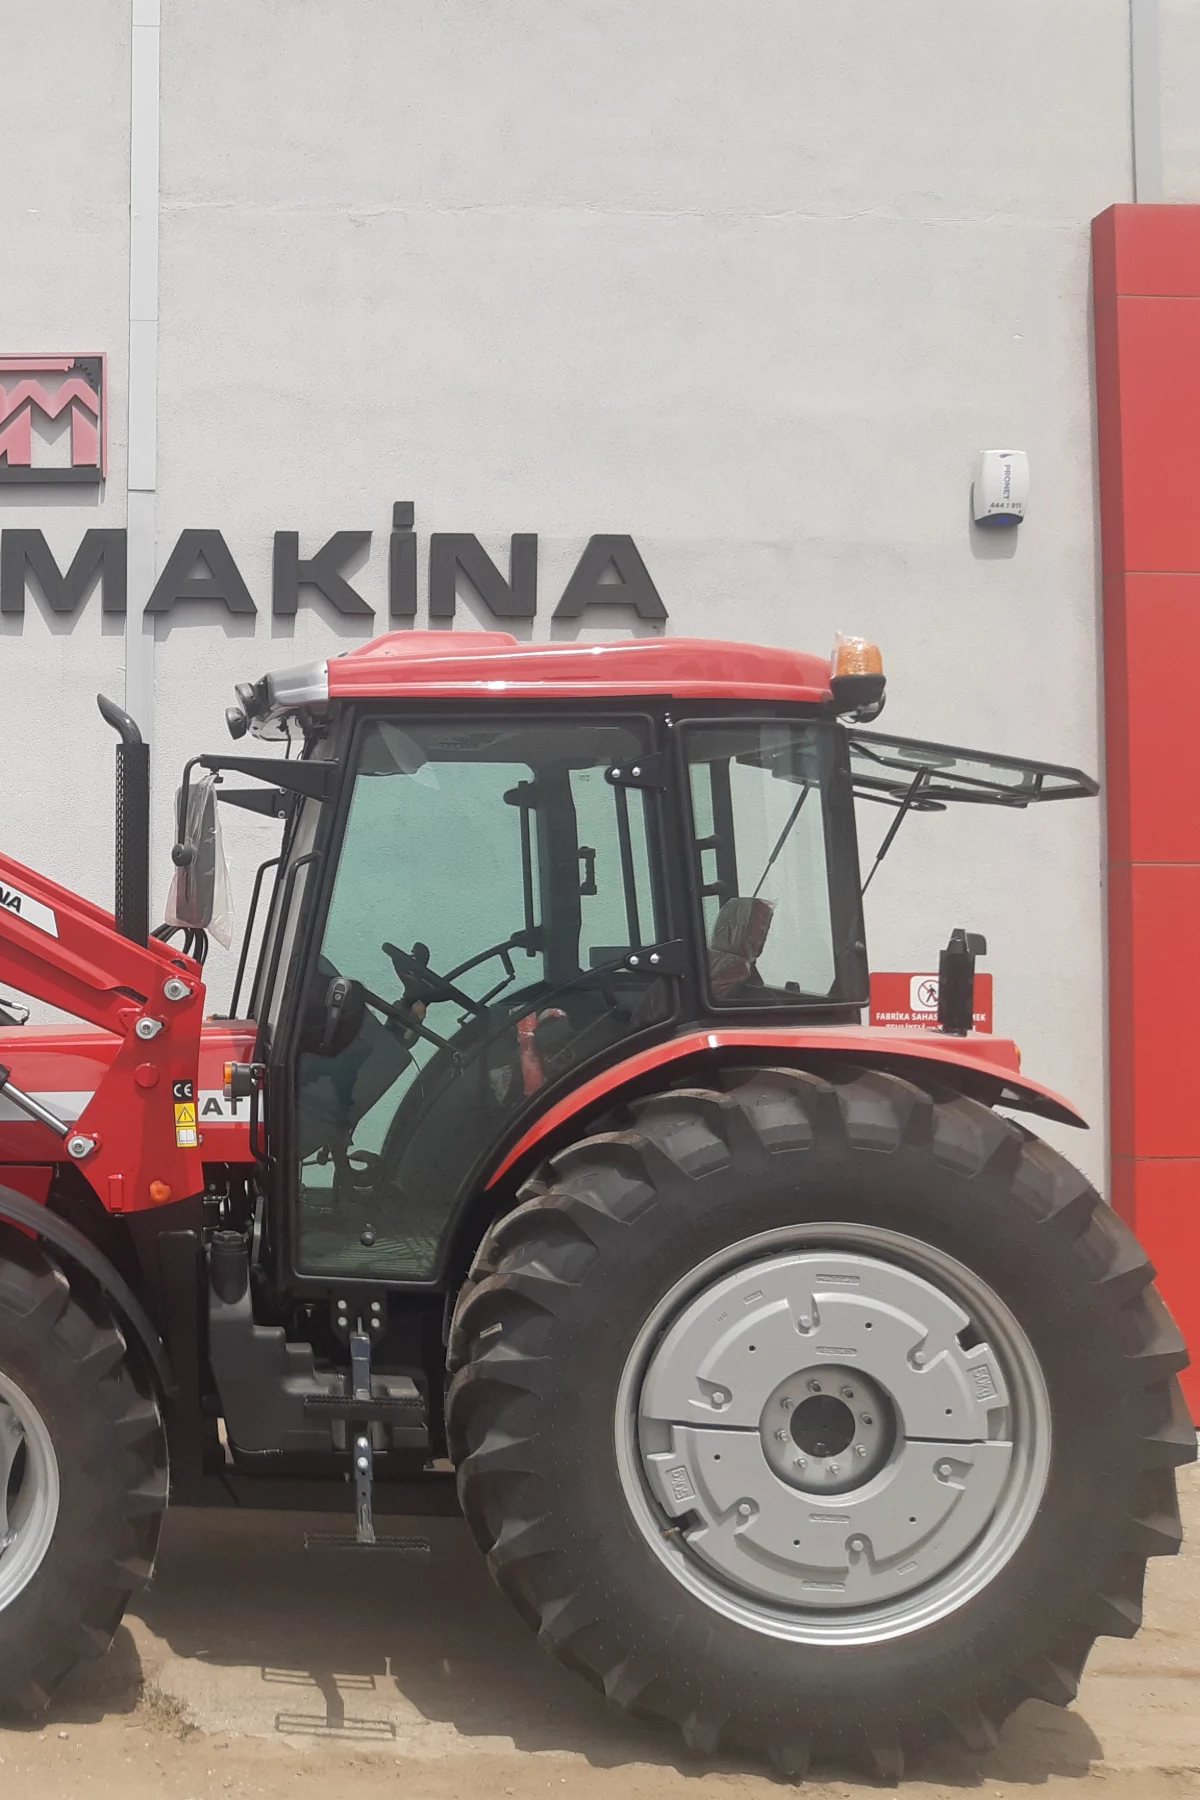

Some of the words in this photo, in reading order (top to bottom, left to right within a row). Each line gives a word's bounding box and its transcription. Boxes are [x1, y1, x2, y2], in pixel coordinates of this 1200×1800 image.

[1003, 464, 1011, 500] PRONET
[0, 501, 668, 619] MAKİNA
[876, 1011, 910, 1021] FABRİKA
[912, 1013, 938, 1021] SAHAS
[174, 1084, 192, 1097] CE
[198, 1097, 243, 1115] AT
